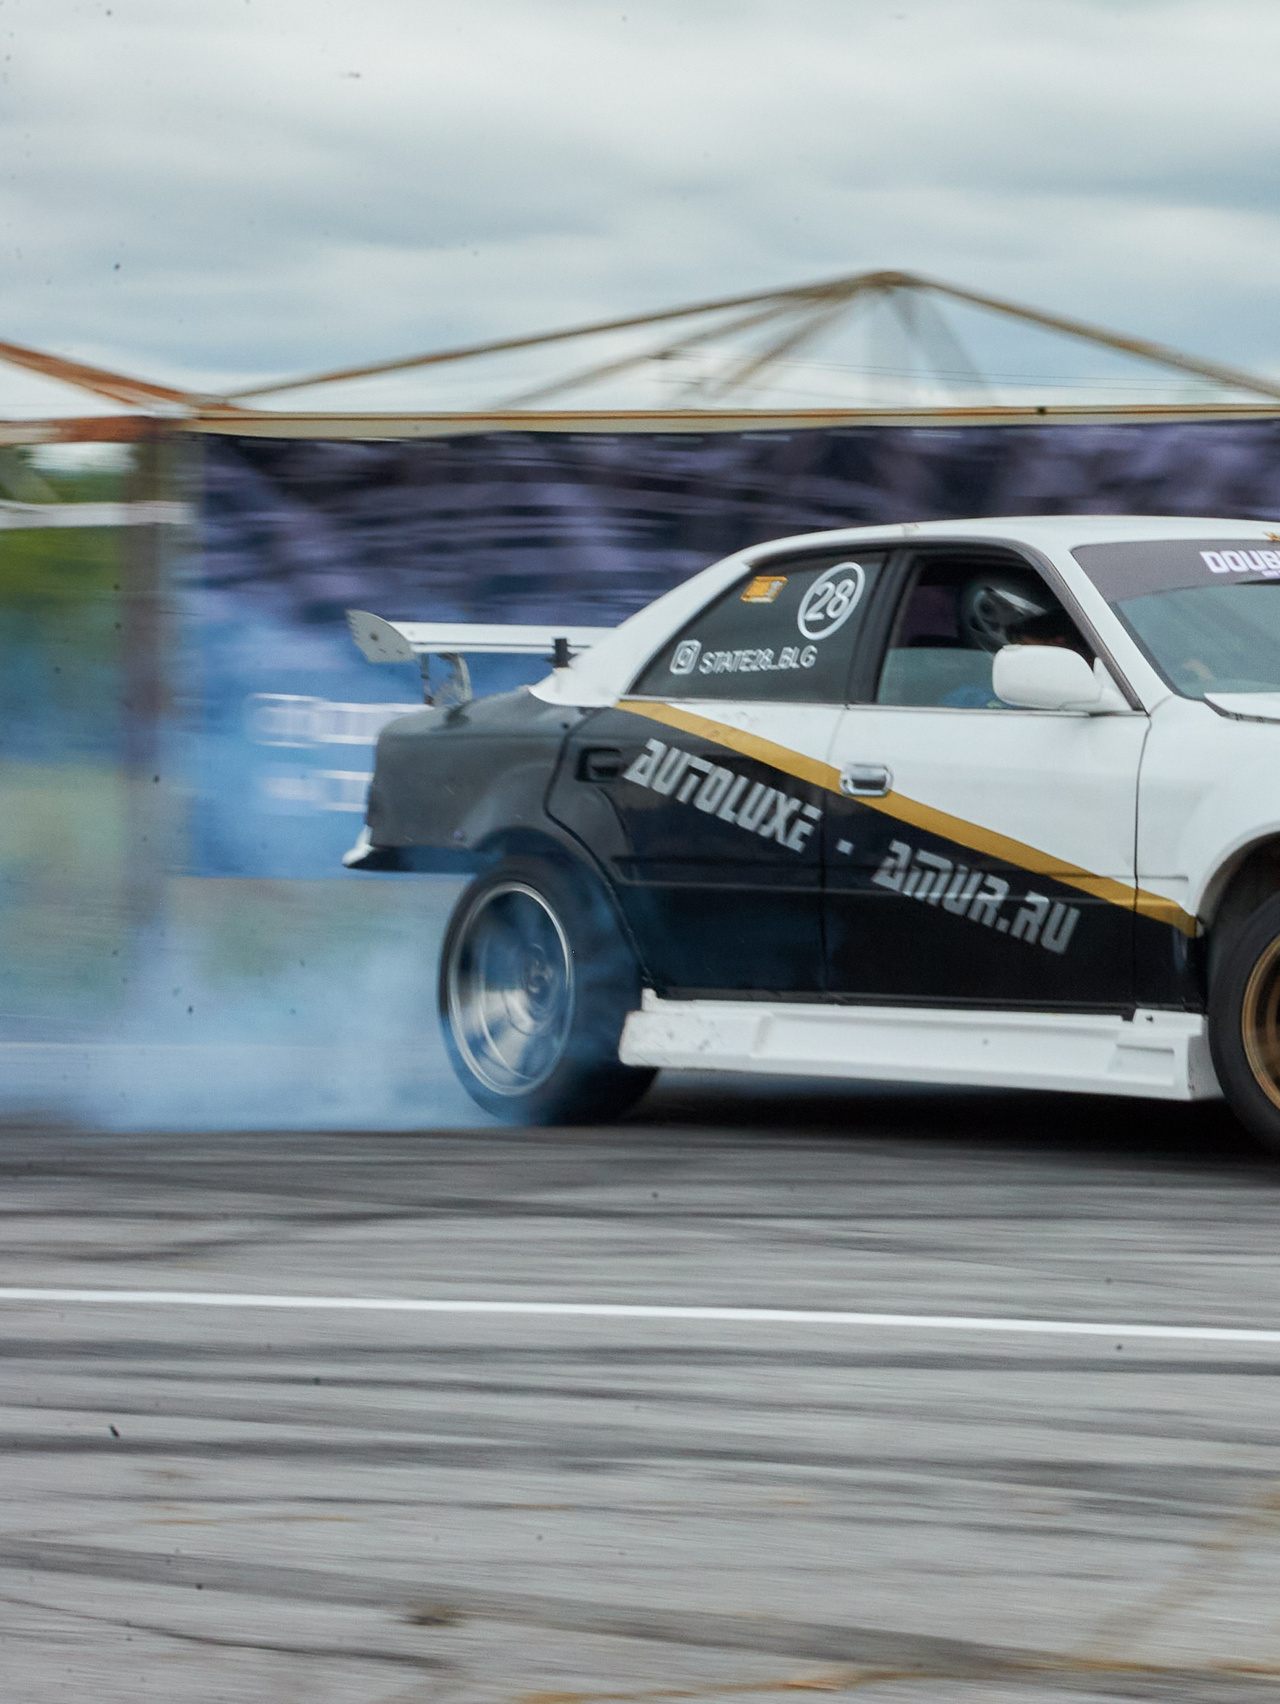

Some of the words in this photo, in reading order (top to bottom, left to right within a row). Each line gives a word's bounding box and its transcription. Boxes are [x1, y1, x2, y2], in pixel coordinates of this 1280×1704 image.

[803, 577, 856, 623] 28
[624, 738, 823, 853] AUTOLUXE
[871, 838, 1082, 954] AMUR.RU
